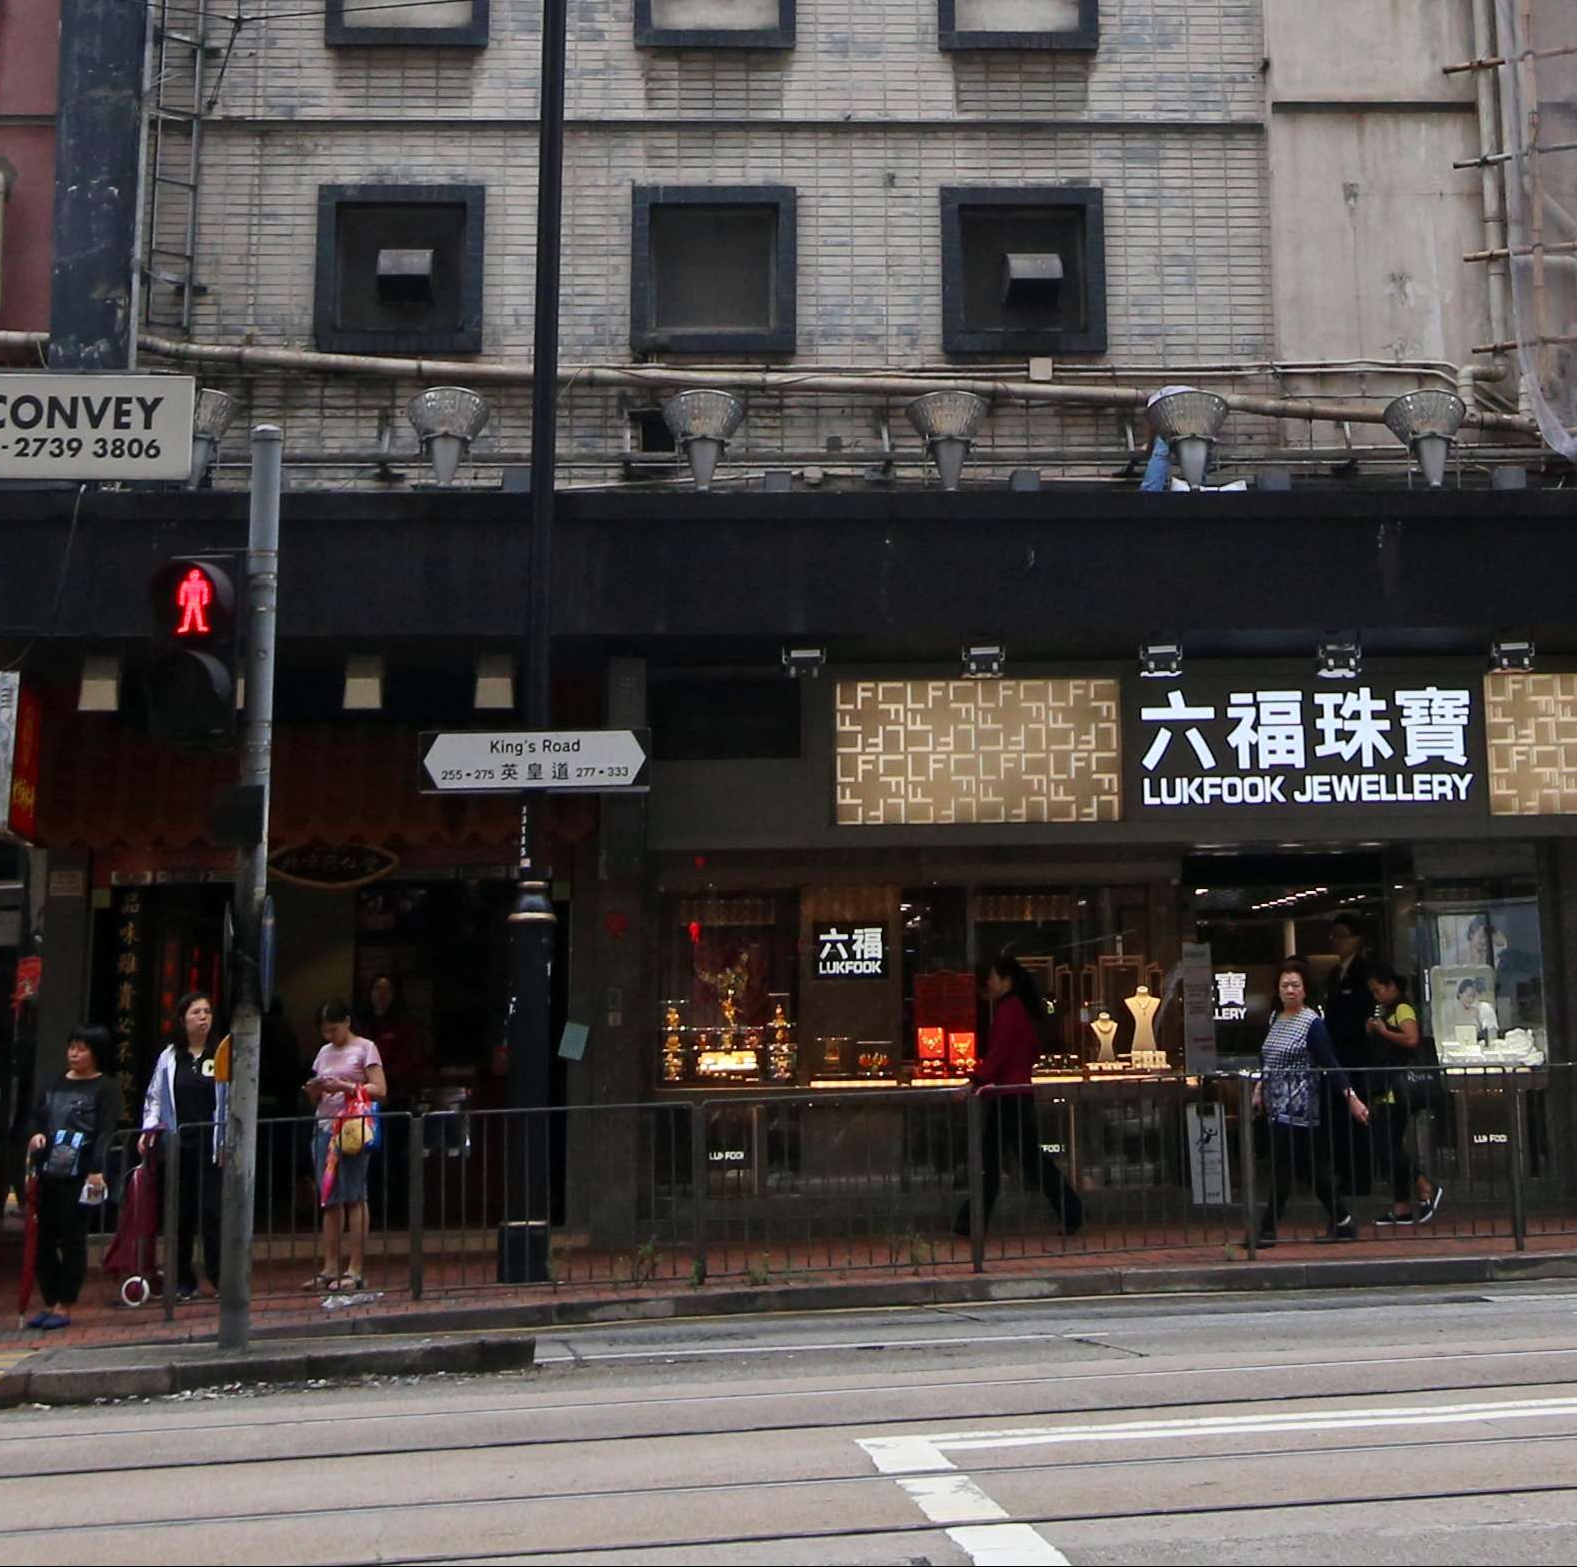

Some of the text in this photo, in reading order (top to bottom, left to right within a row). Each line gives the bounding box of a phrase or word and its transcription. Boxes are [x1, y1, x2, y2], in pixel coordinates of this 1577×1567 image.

[93, 437, 161, 458] 3806
[1141, 687, 1471, 771] 六福珠寶
[490, 739, 581, 756] King's Road
[501, 763, 570, 781] 英皇道
[1142, 773, 1475, 805] LUKFOOK JEWELLERY
[818, 927, 883, 960] 六福
[818, 961, 883, 974] LUKFOOK
[1211, 971, 1246, 1006] 寶
